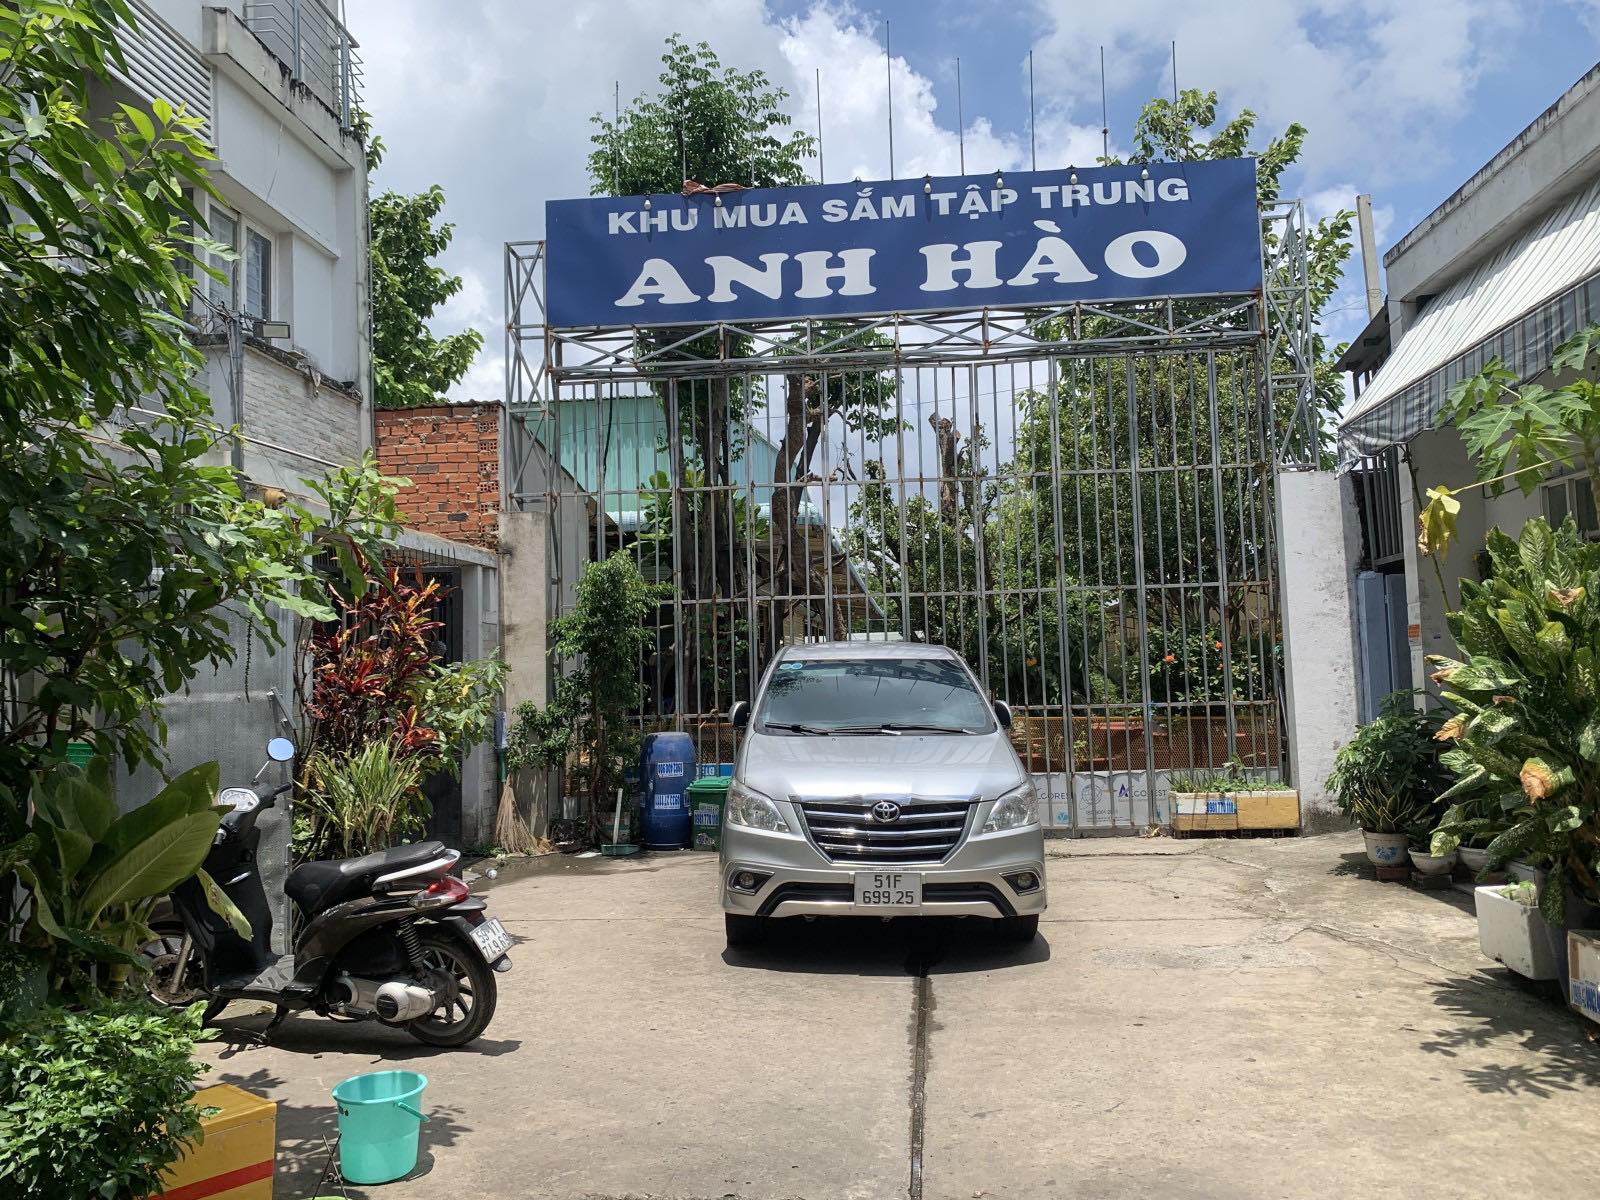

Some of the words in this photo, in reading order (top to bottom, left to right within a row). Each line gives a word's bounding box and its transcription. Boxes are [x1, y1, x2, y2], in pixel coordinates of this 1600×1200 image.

[608, 207, 699, 235] KHU
[712, 201, 807, 230] MUA
[821, 187, 916, 224] SẮM
[929, 183, 1018, 219] TẬP
[1032, 177, 1190, 209] TRUNG
[614, 247, 878, 307] ANH
[919, 219, 1187, 292] HÀO
[863, 890, 914, 904] 699.25
[874, 875, 902, 888] 51F
